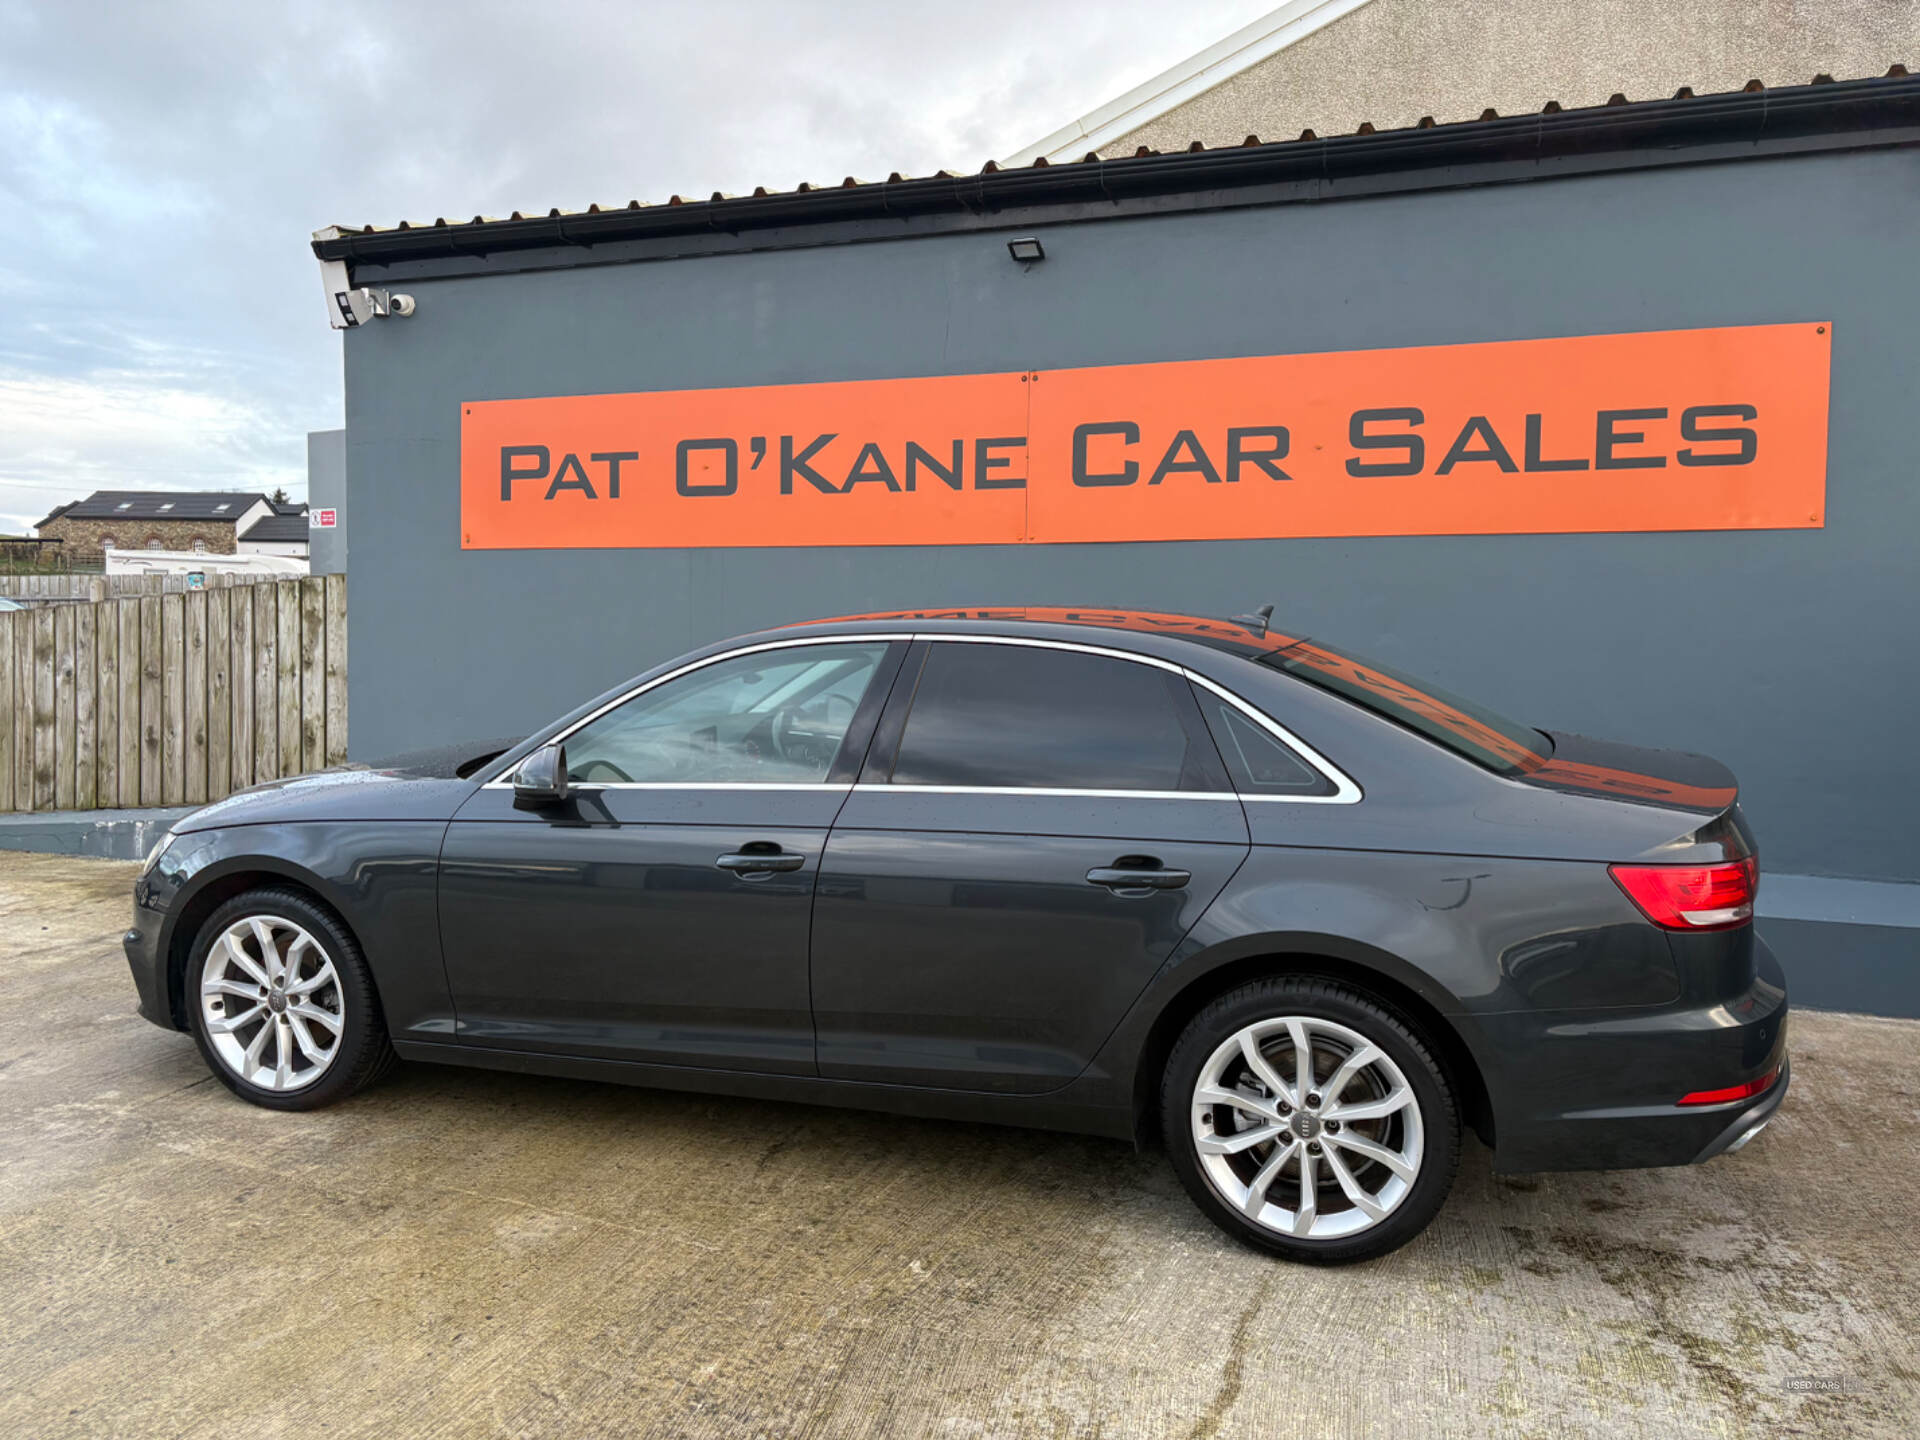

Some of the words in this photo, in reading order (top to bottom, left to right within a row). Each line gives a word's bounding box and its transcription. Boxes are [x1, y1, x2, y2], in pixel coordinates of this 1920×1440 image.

[500, 445, 638, 501] PAT
[676, 434, 1028, 497] O'KANE
[1072, 422, 1293, 487] CAR
[1346, 404, 1758, 477] SALES
